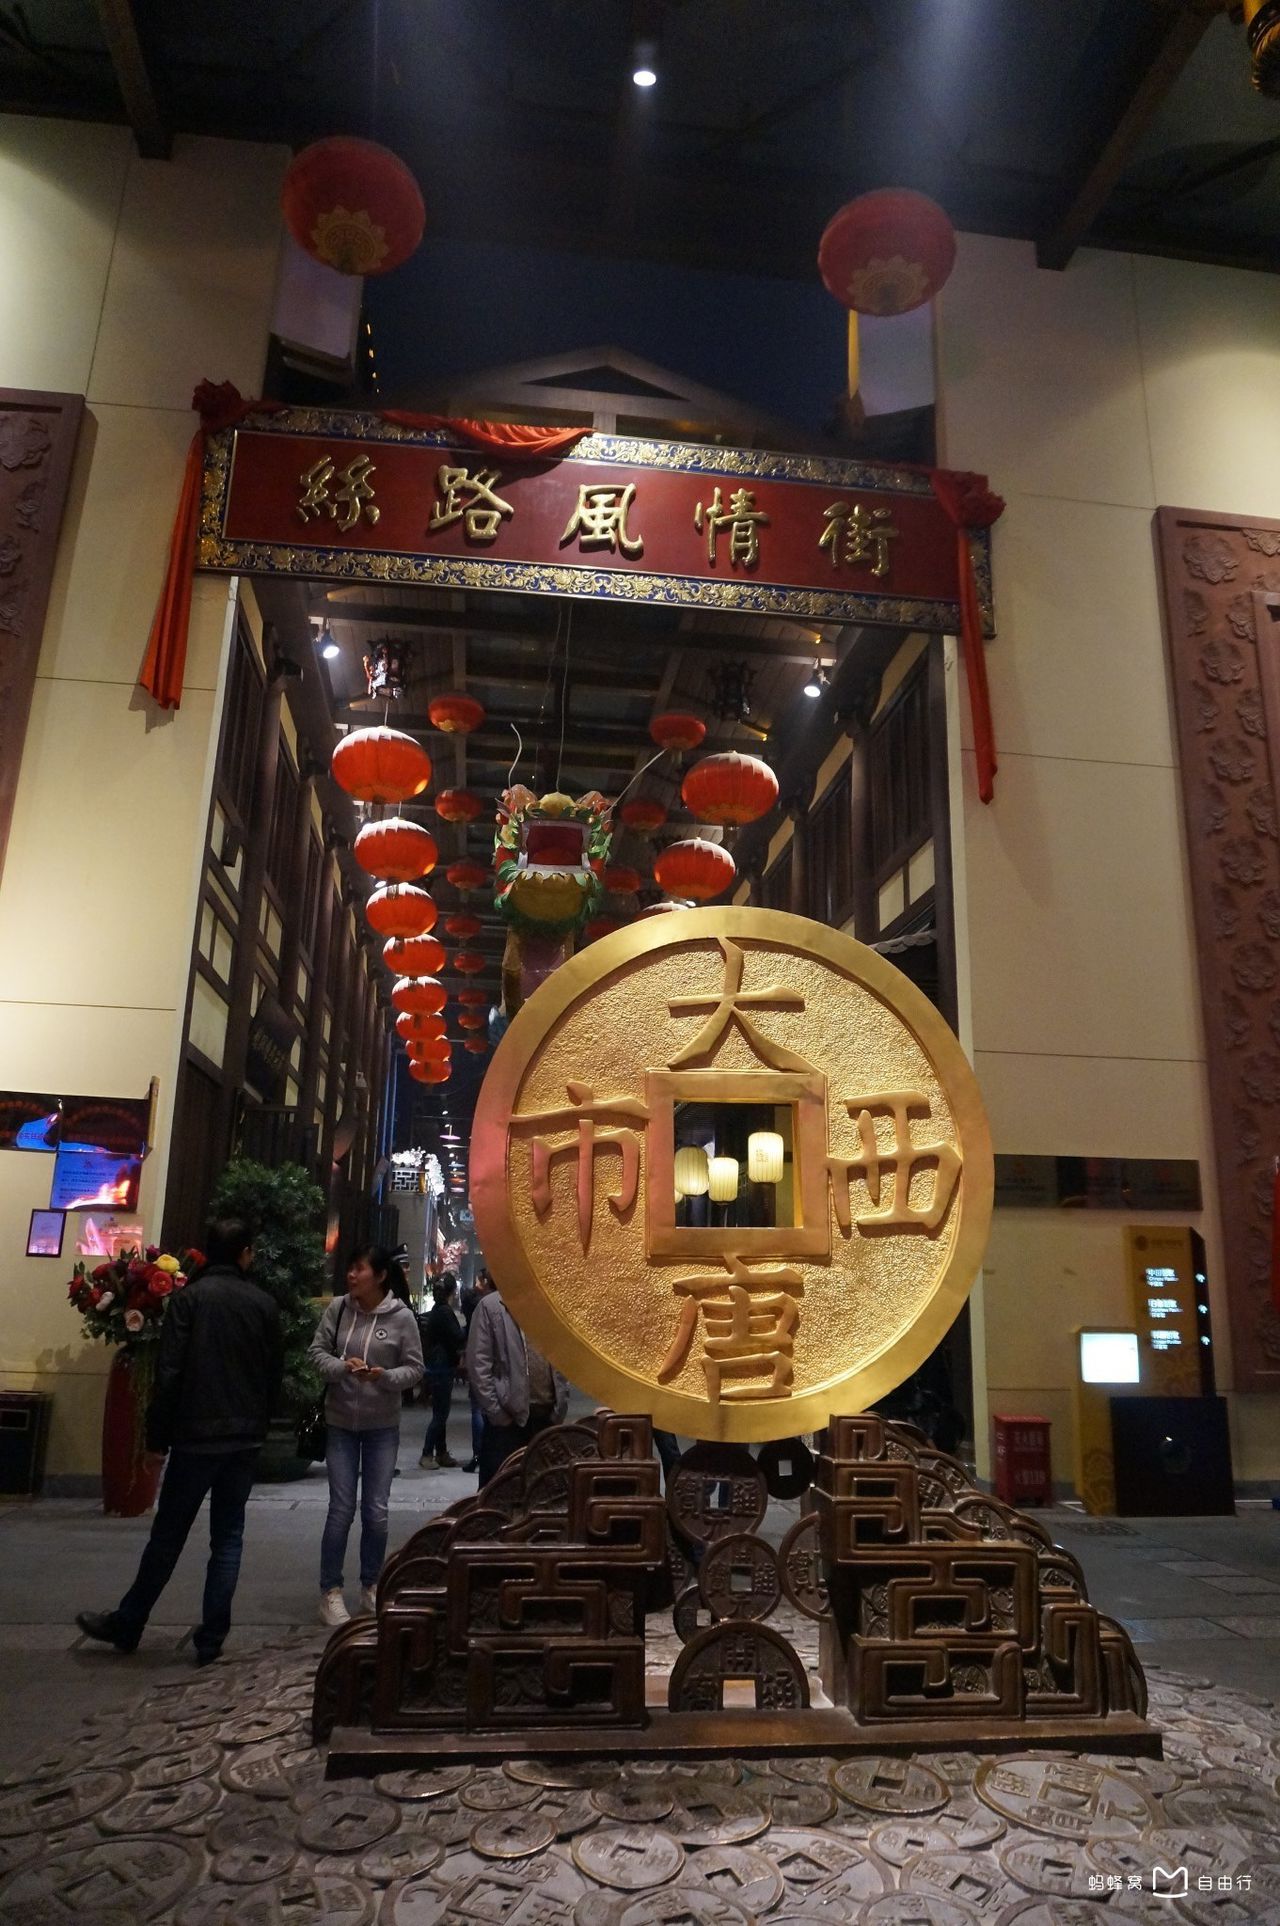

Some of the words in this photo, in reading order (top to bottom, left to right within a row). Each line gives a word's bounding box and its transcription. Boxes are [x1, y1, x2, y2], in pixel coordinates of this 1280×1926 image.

[296, 453, 899, 577] 絲路風情街
